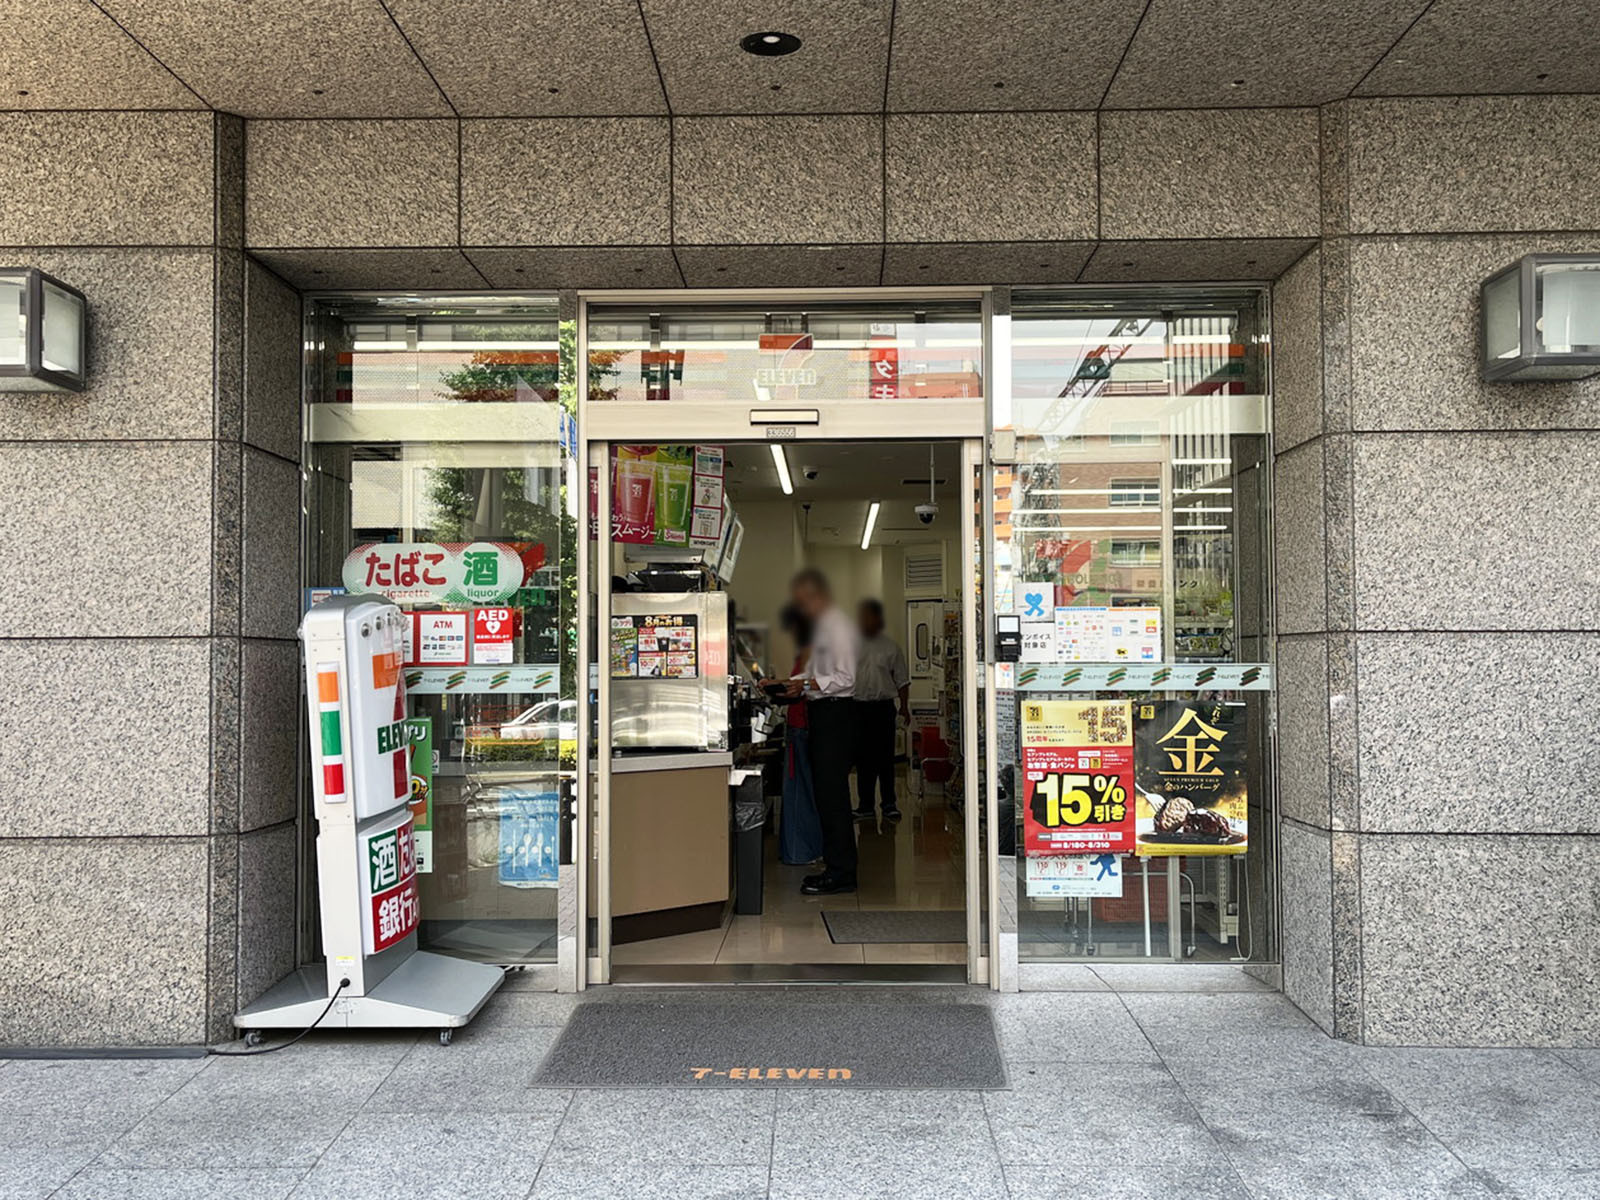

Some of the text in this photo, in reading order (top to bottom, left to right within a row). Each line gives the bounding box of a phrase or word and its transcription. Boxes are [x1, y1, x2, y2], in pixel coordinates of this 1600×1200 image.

[365, 551, 447, 587] たばこ
[463, 551, 499, 586] 酒
[467, 588, 500, 599] liquor
[433, 620, 453, 629] ATM
[476, 610, 509, 621] AED
[1078, 705, 1127, 743] 15
[1155, 707, 1228, 776] 金
[1036, 773, 1125, 827] 15%
[1164, 781, 1221, 792] 金のハンバーグ
[1094, 804, 1125, 822] 引き
[371, 835, 396, 890] 酒
